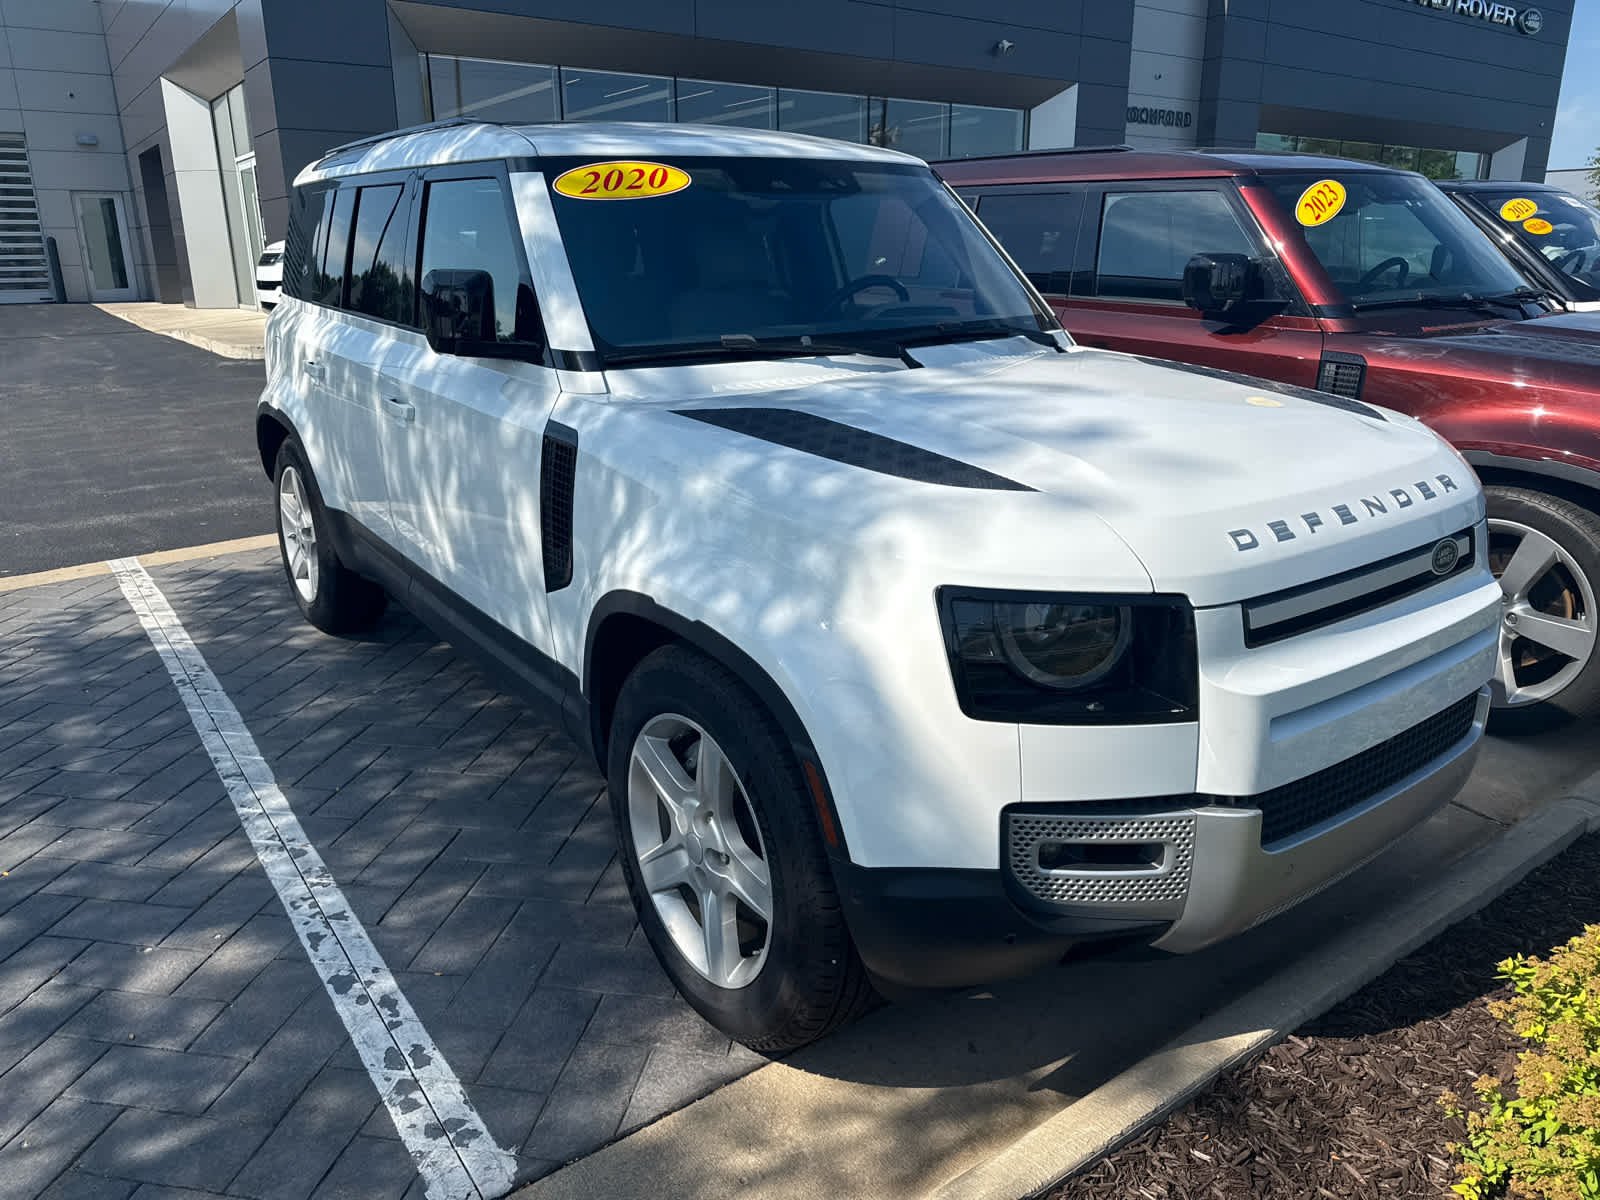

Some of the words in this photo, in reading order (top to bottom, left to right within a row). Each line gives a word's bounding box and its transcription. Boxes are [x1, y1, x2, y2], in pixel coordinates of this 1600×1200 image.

[1456, 0, 1516, 26] ROVER
[579, 168, 669, 194] 2020
[1304, 184, 1339, 221] 2023
[1227, 474, 1459, 552] DEFENDER
